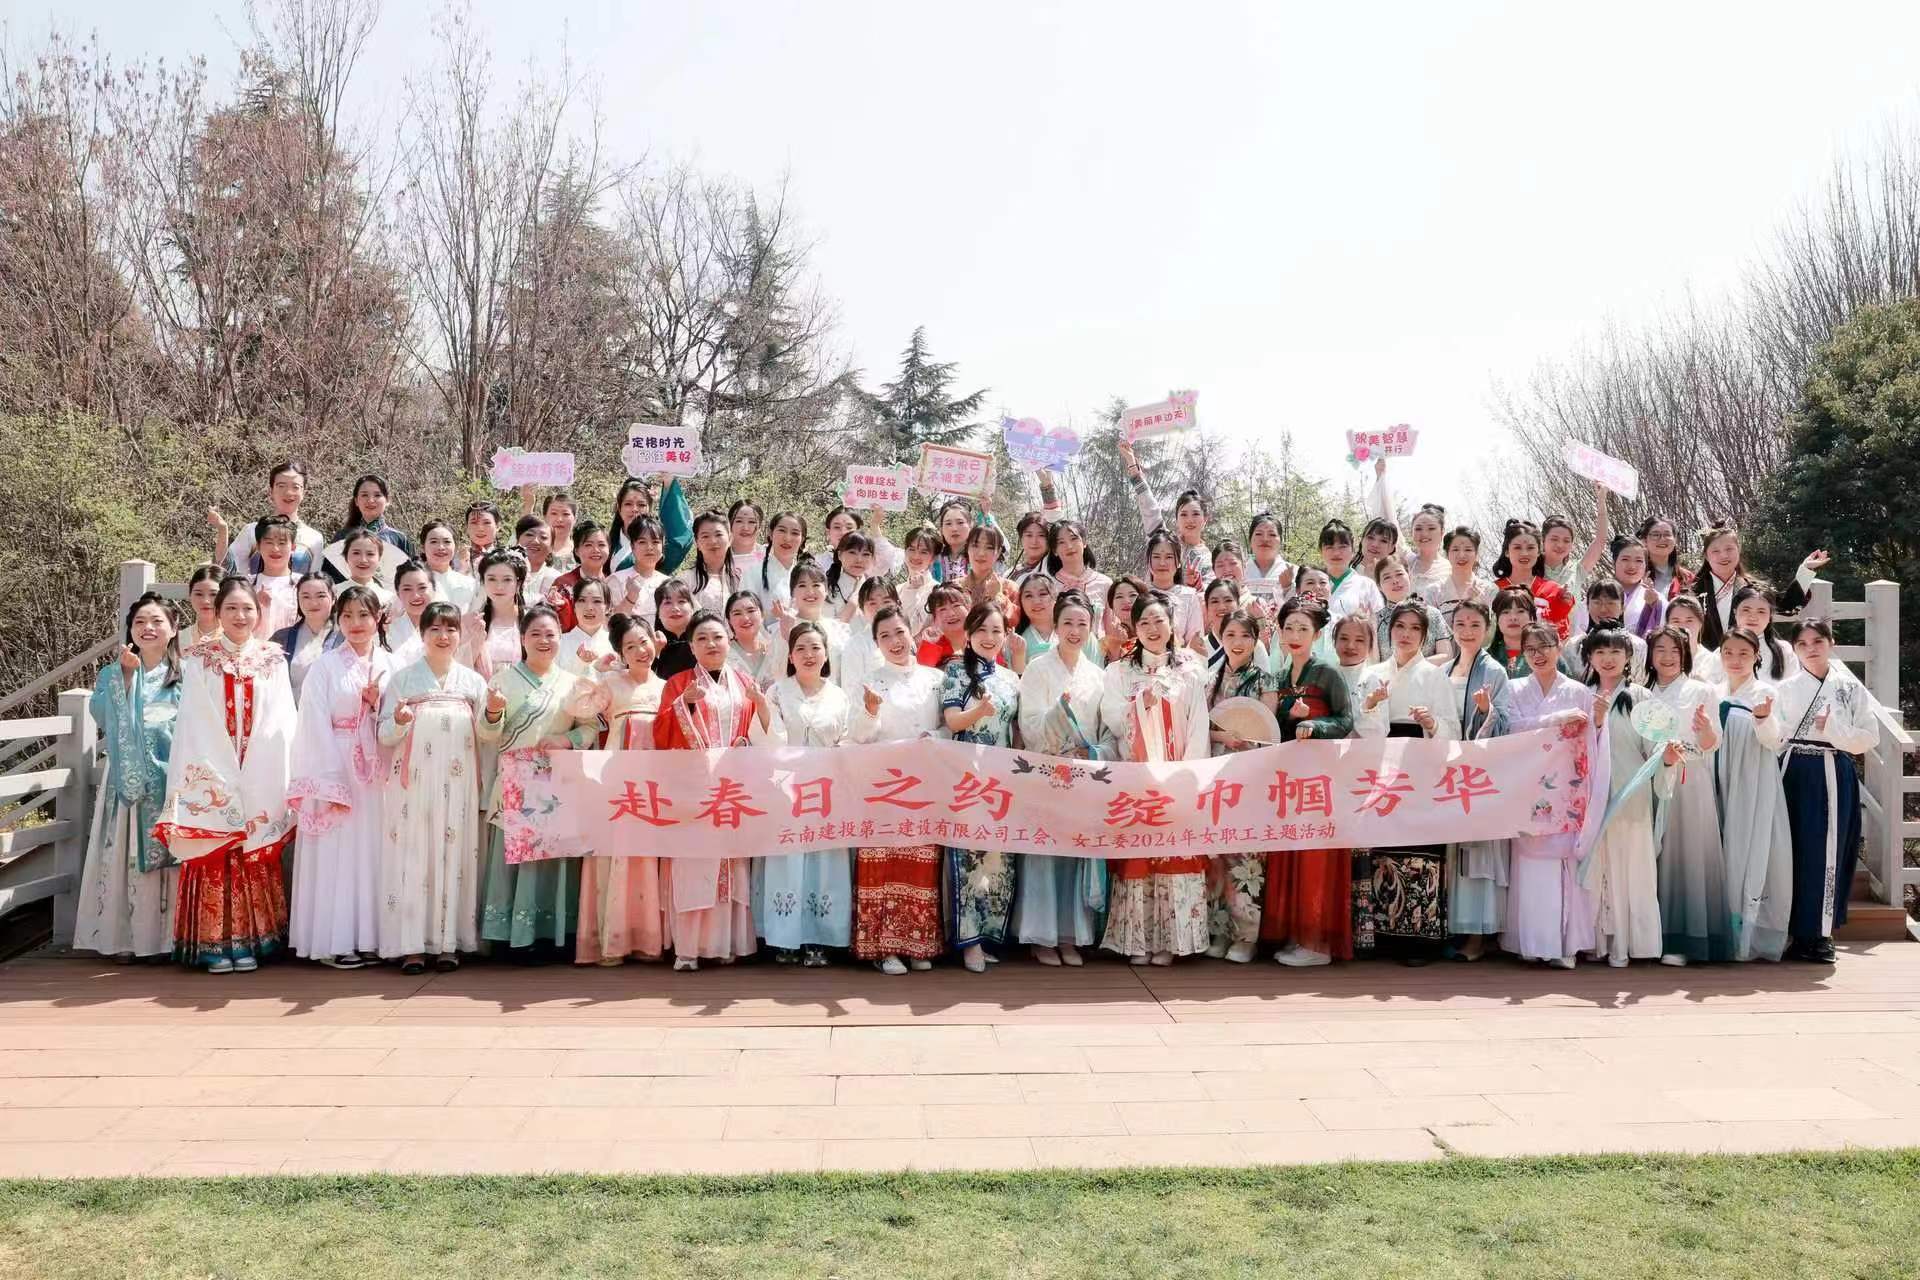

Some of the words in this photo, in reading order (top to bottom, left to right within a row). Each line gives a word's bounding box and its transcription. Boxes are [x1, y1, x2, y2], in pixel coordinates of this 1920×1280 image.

[632, 437, 685, 449] 定格时光
[854, 474, 897, 487] 优雅绽放
[856, 488, 901, 501] 向阳生长
[608, 768, 1015, 829] 赴春日之约
[1103, 764, 1501, 828] 绽巾帼芳华
